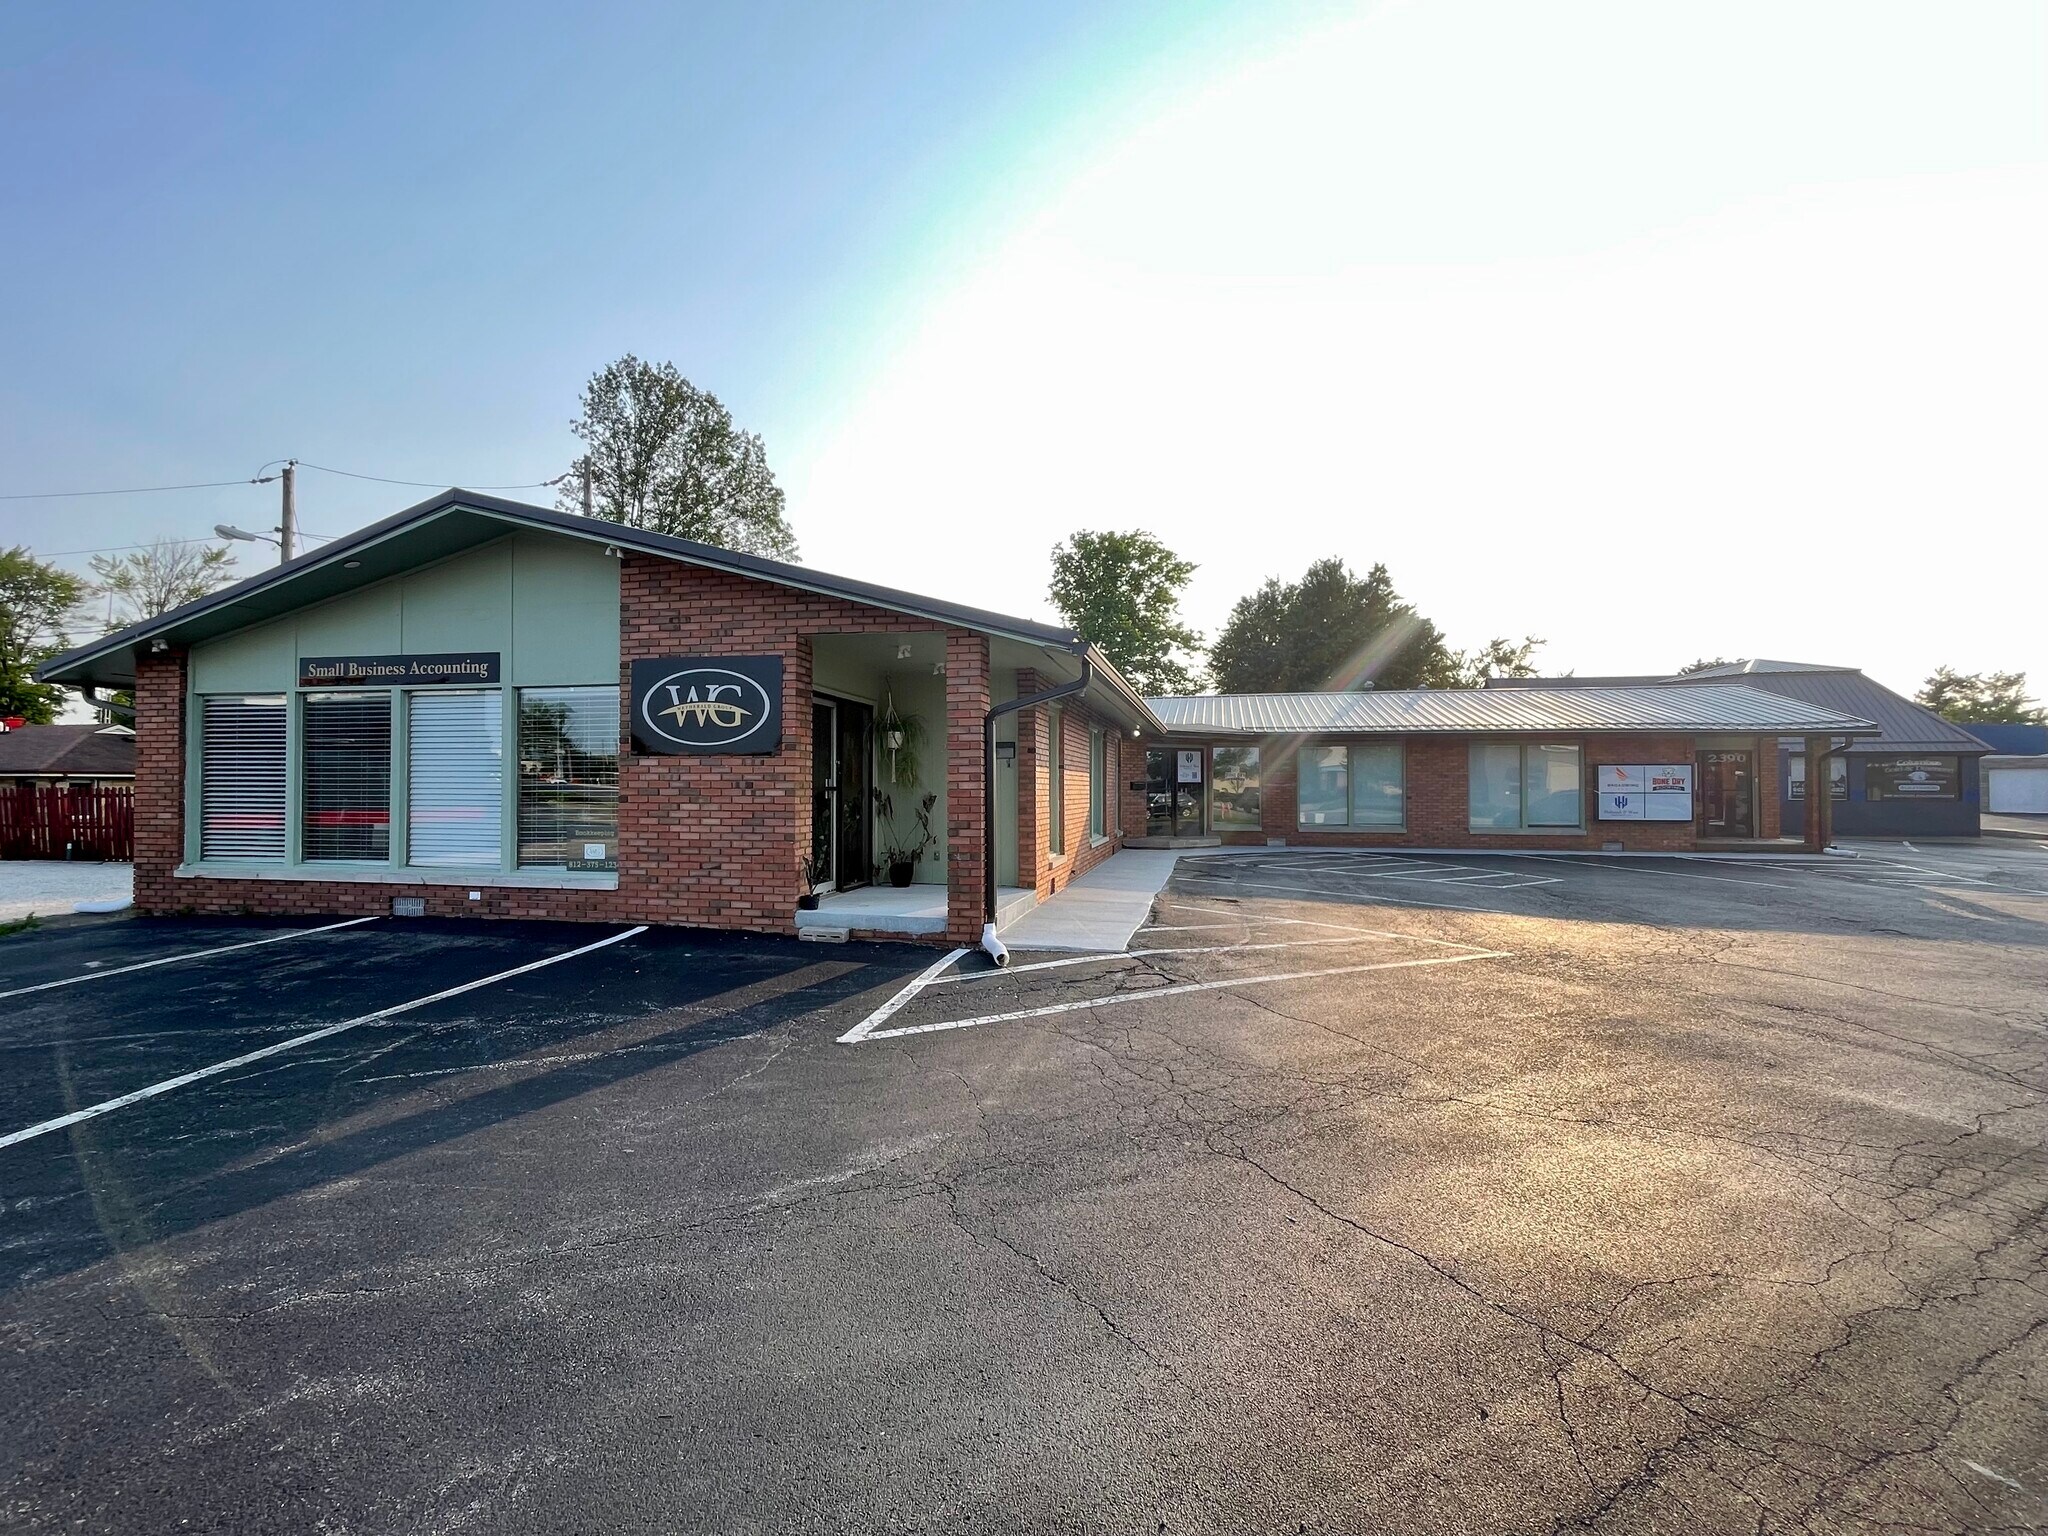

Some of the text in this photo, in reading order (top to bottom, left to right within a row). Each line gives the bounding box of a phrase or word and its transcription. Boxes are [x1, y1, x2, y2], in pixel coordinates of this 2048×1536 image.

[308, 659, 489, 678] Small Business Accounting
[665, 684, 742, 727] WG
[1708, 752, 1746, 763] 2390
[1652, 777, 1686, 785] BONE DRY
